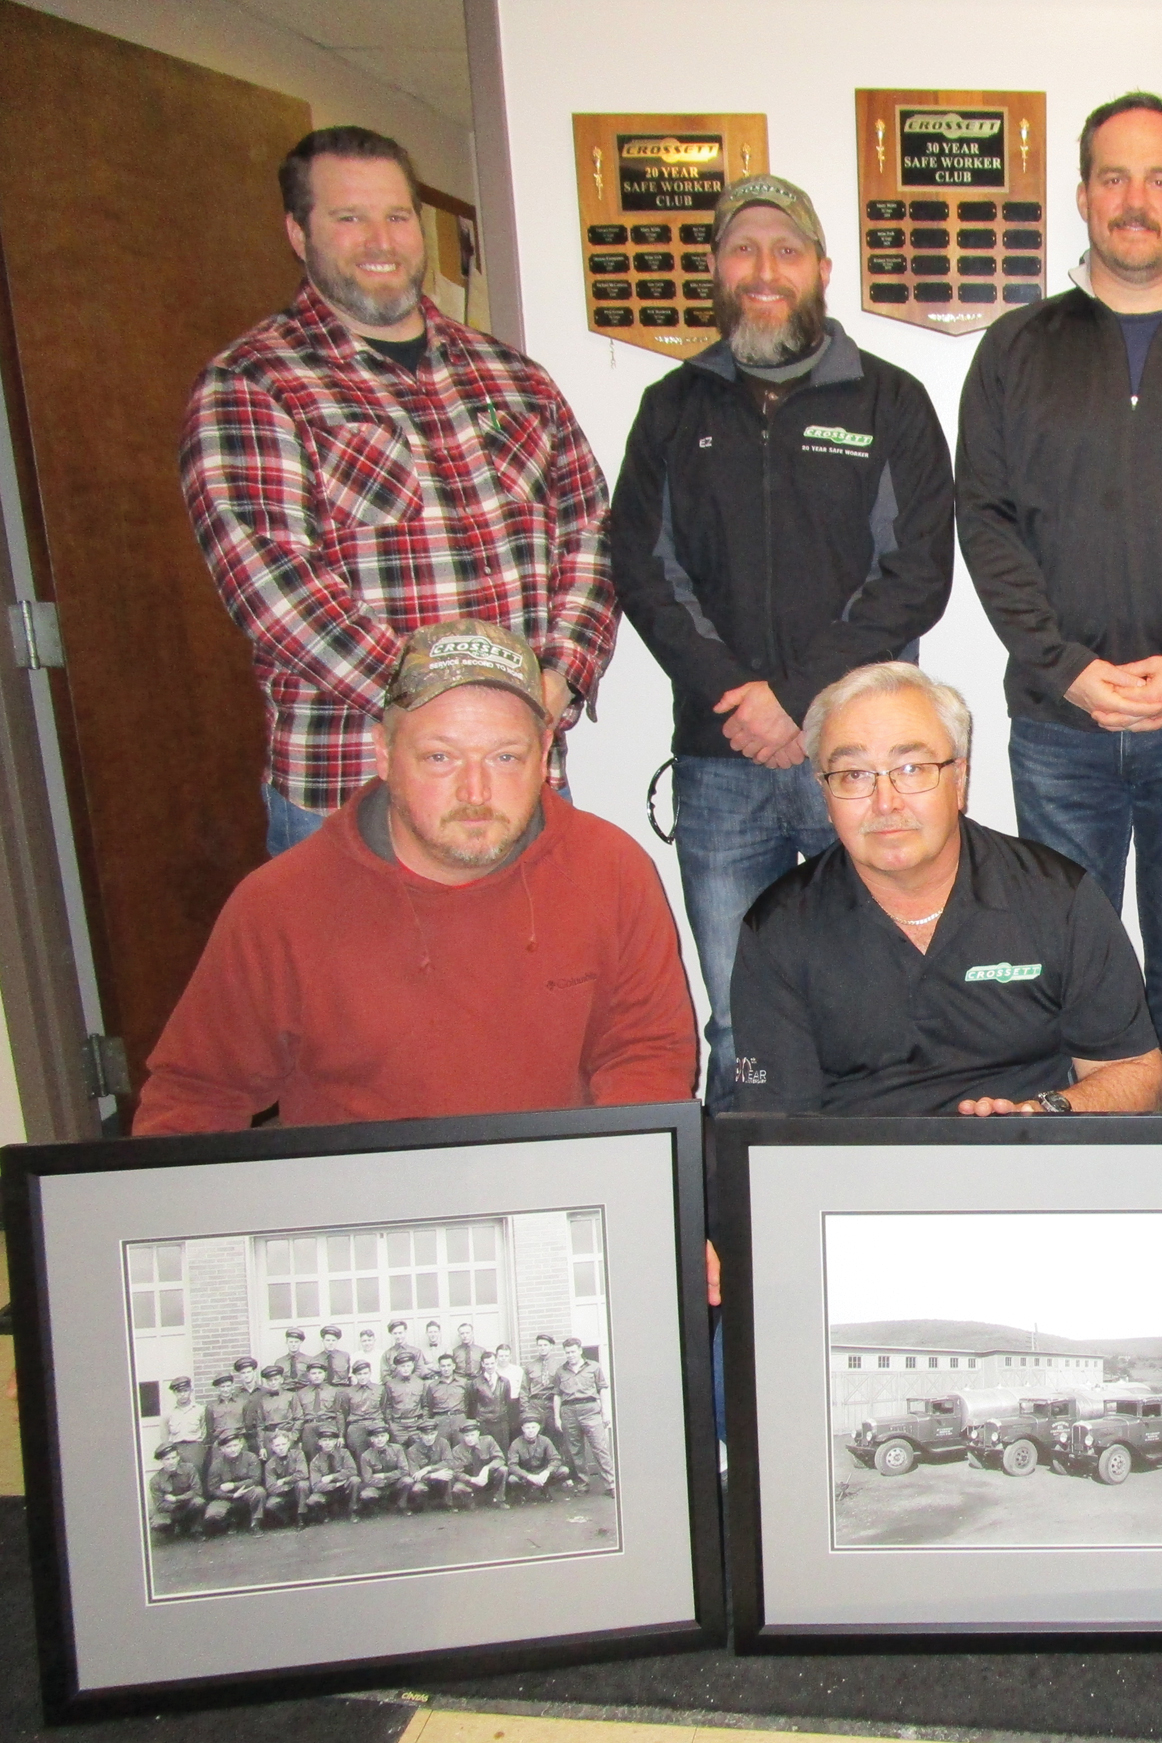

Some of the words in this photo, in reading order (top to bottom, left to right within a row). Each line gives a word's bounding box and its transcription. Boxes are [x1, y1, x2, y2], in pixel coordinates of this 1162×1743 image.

[907, 121, 998, 131] CROSSETT
[626, 144, 717, 156] CROSSETT
[926, 142, 940, 154] 30
[942, 142, 979, 154] YEAR
[904, 156, 938, 168] SAFE
[941, 156, 1001, 169] WORKER
[645, 166, 659, 178] 20
[661, 166, 699, 178] YEAR
[935, 171, 972, 183] CLUB
[623, 181, 658, 193] SAFE
[661, 180, 721, 193] WORKER
[656, 195, 693, 207] CLUB
[806, 429, 870, 443] CROSSETT
[845, 449, 869, 458] WORKER
[433, 643, 520, 663] CROSSETT
[429, 659, 460, 670] SERVICE
[462, 659, 494, 668] SECOND
[495, 663, 506, 671] TO
[968, 966, 1041, 980] CROSSETT
